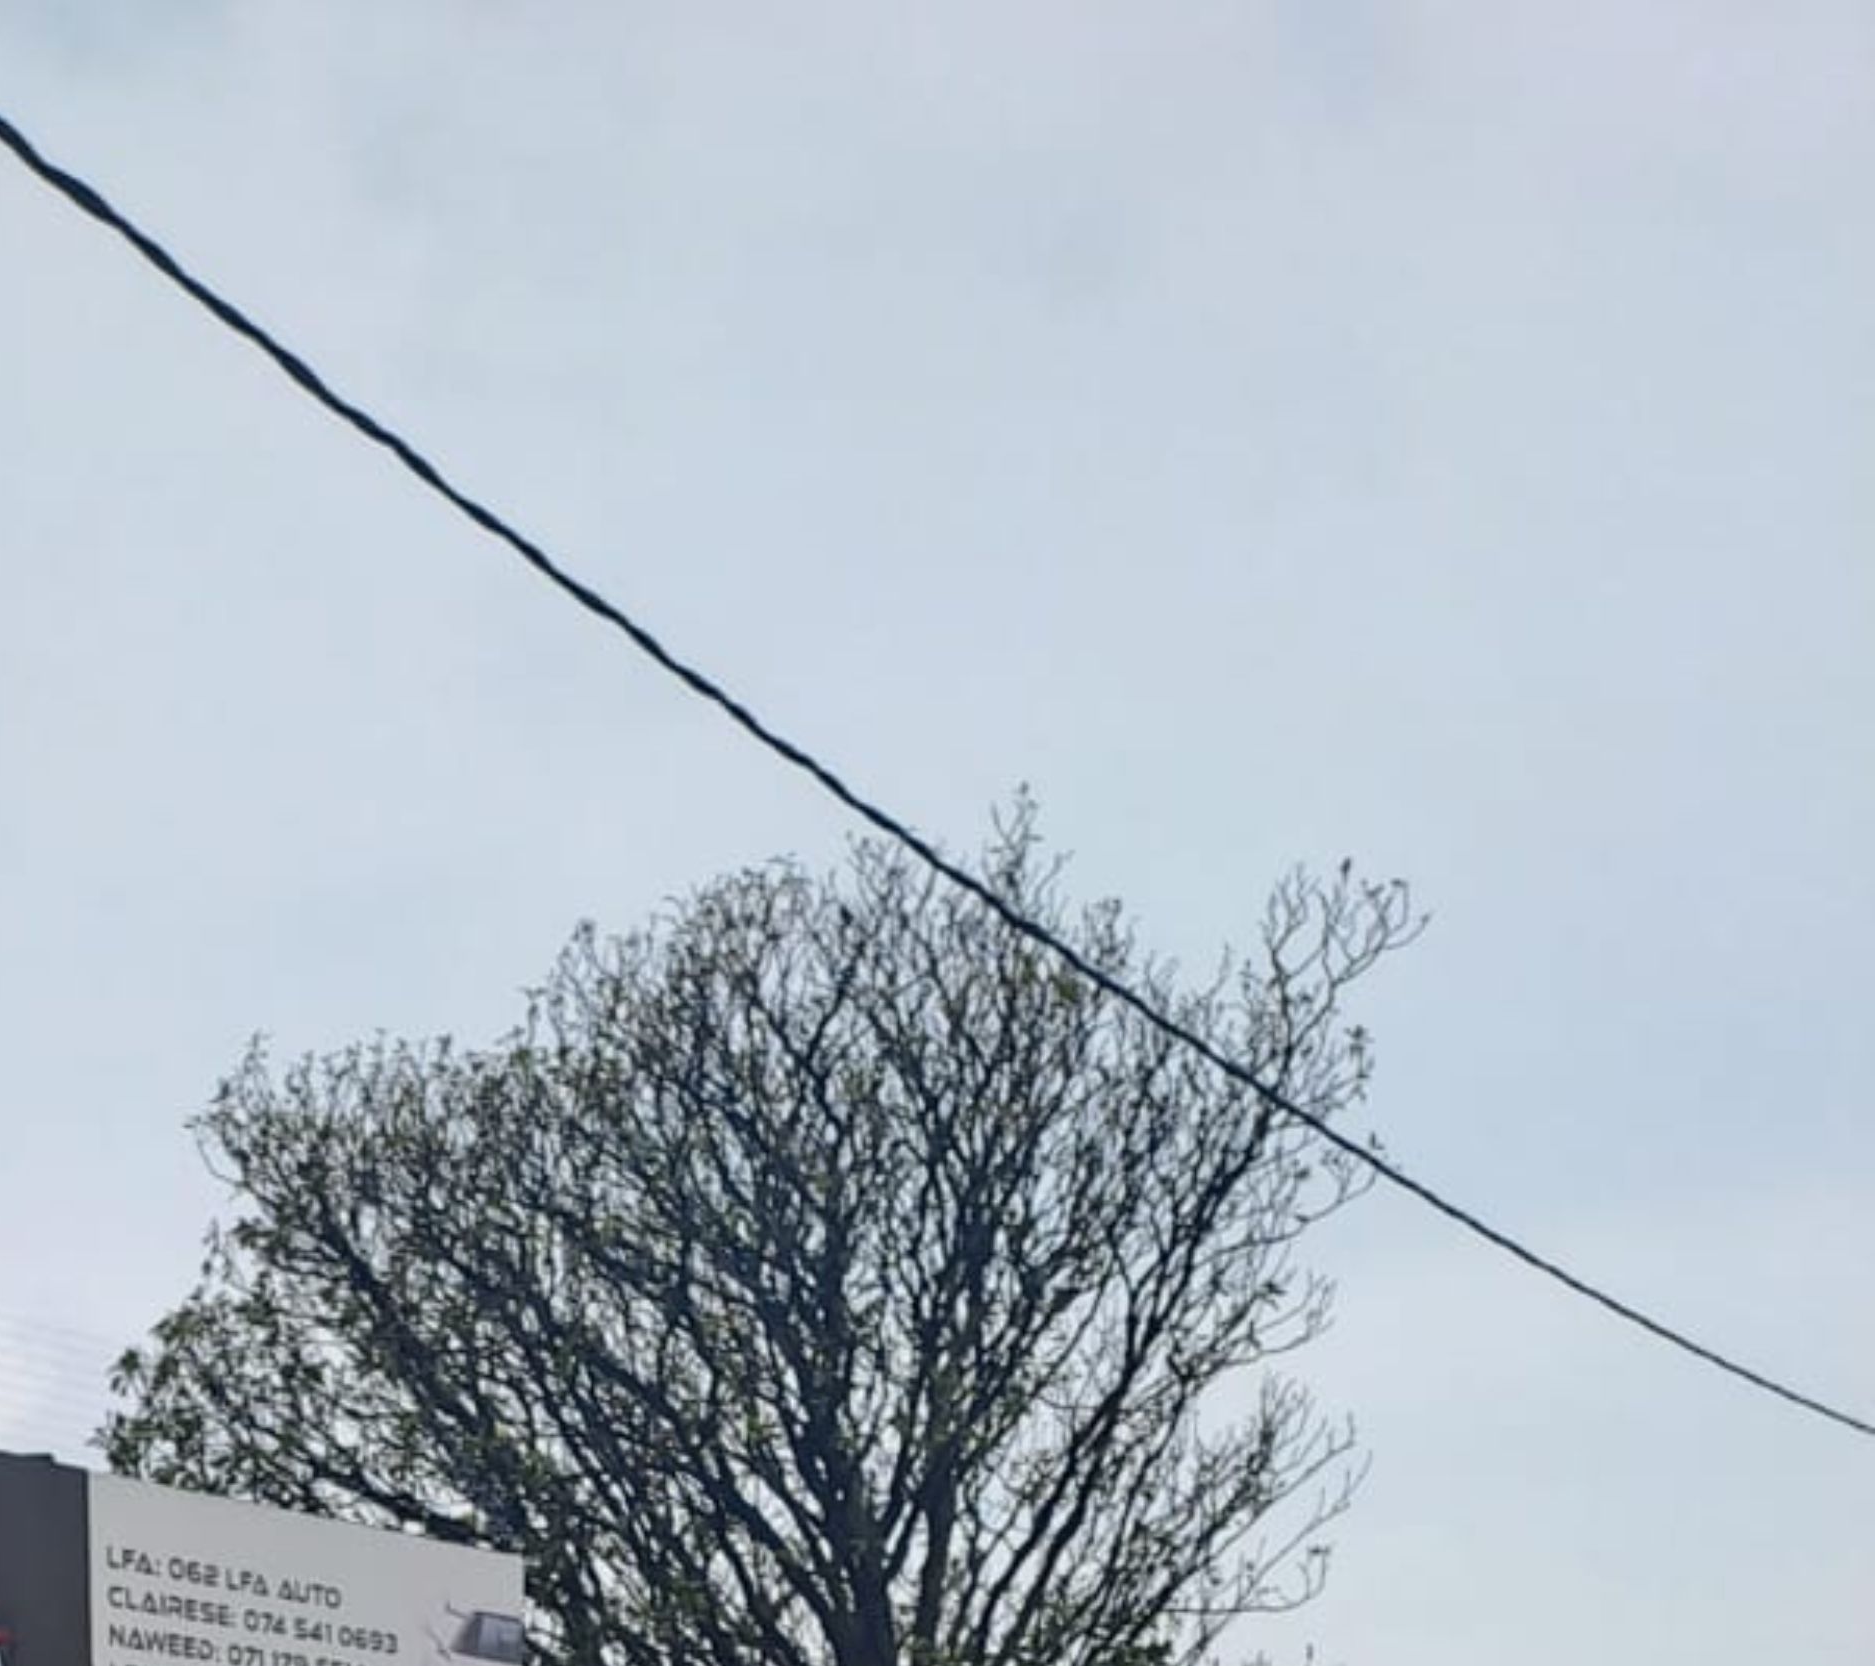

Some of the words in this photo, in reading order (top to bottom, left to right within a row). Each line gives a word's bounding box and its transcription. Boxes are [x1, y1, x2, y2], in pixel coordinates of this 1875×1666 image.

[106, 1546, 160, 1577] LFA:
[168, 1557, 219, 1587] 062
[226, 1568, 269, 1596] LFA
[278, 1579, 341, 1609] AUTO
